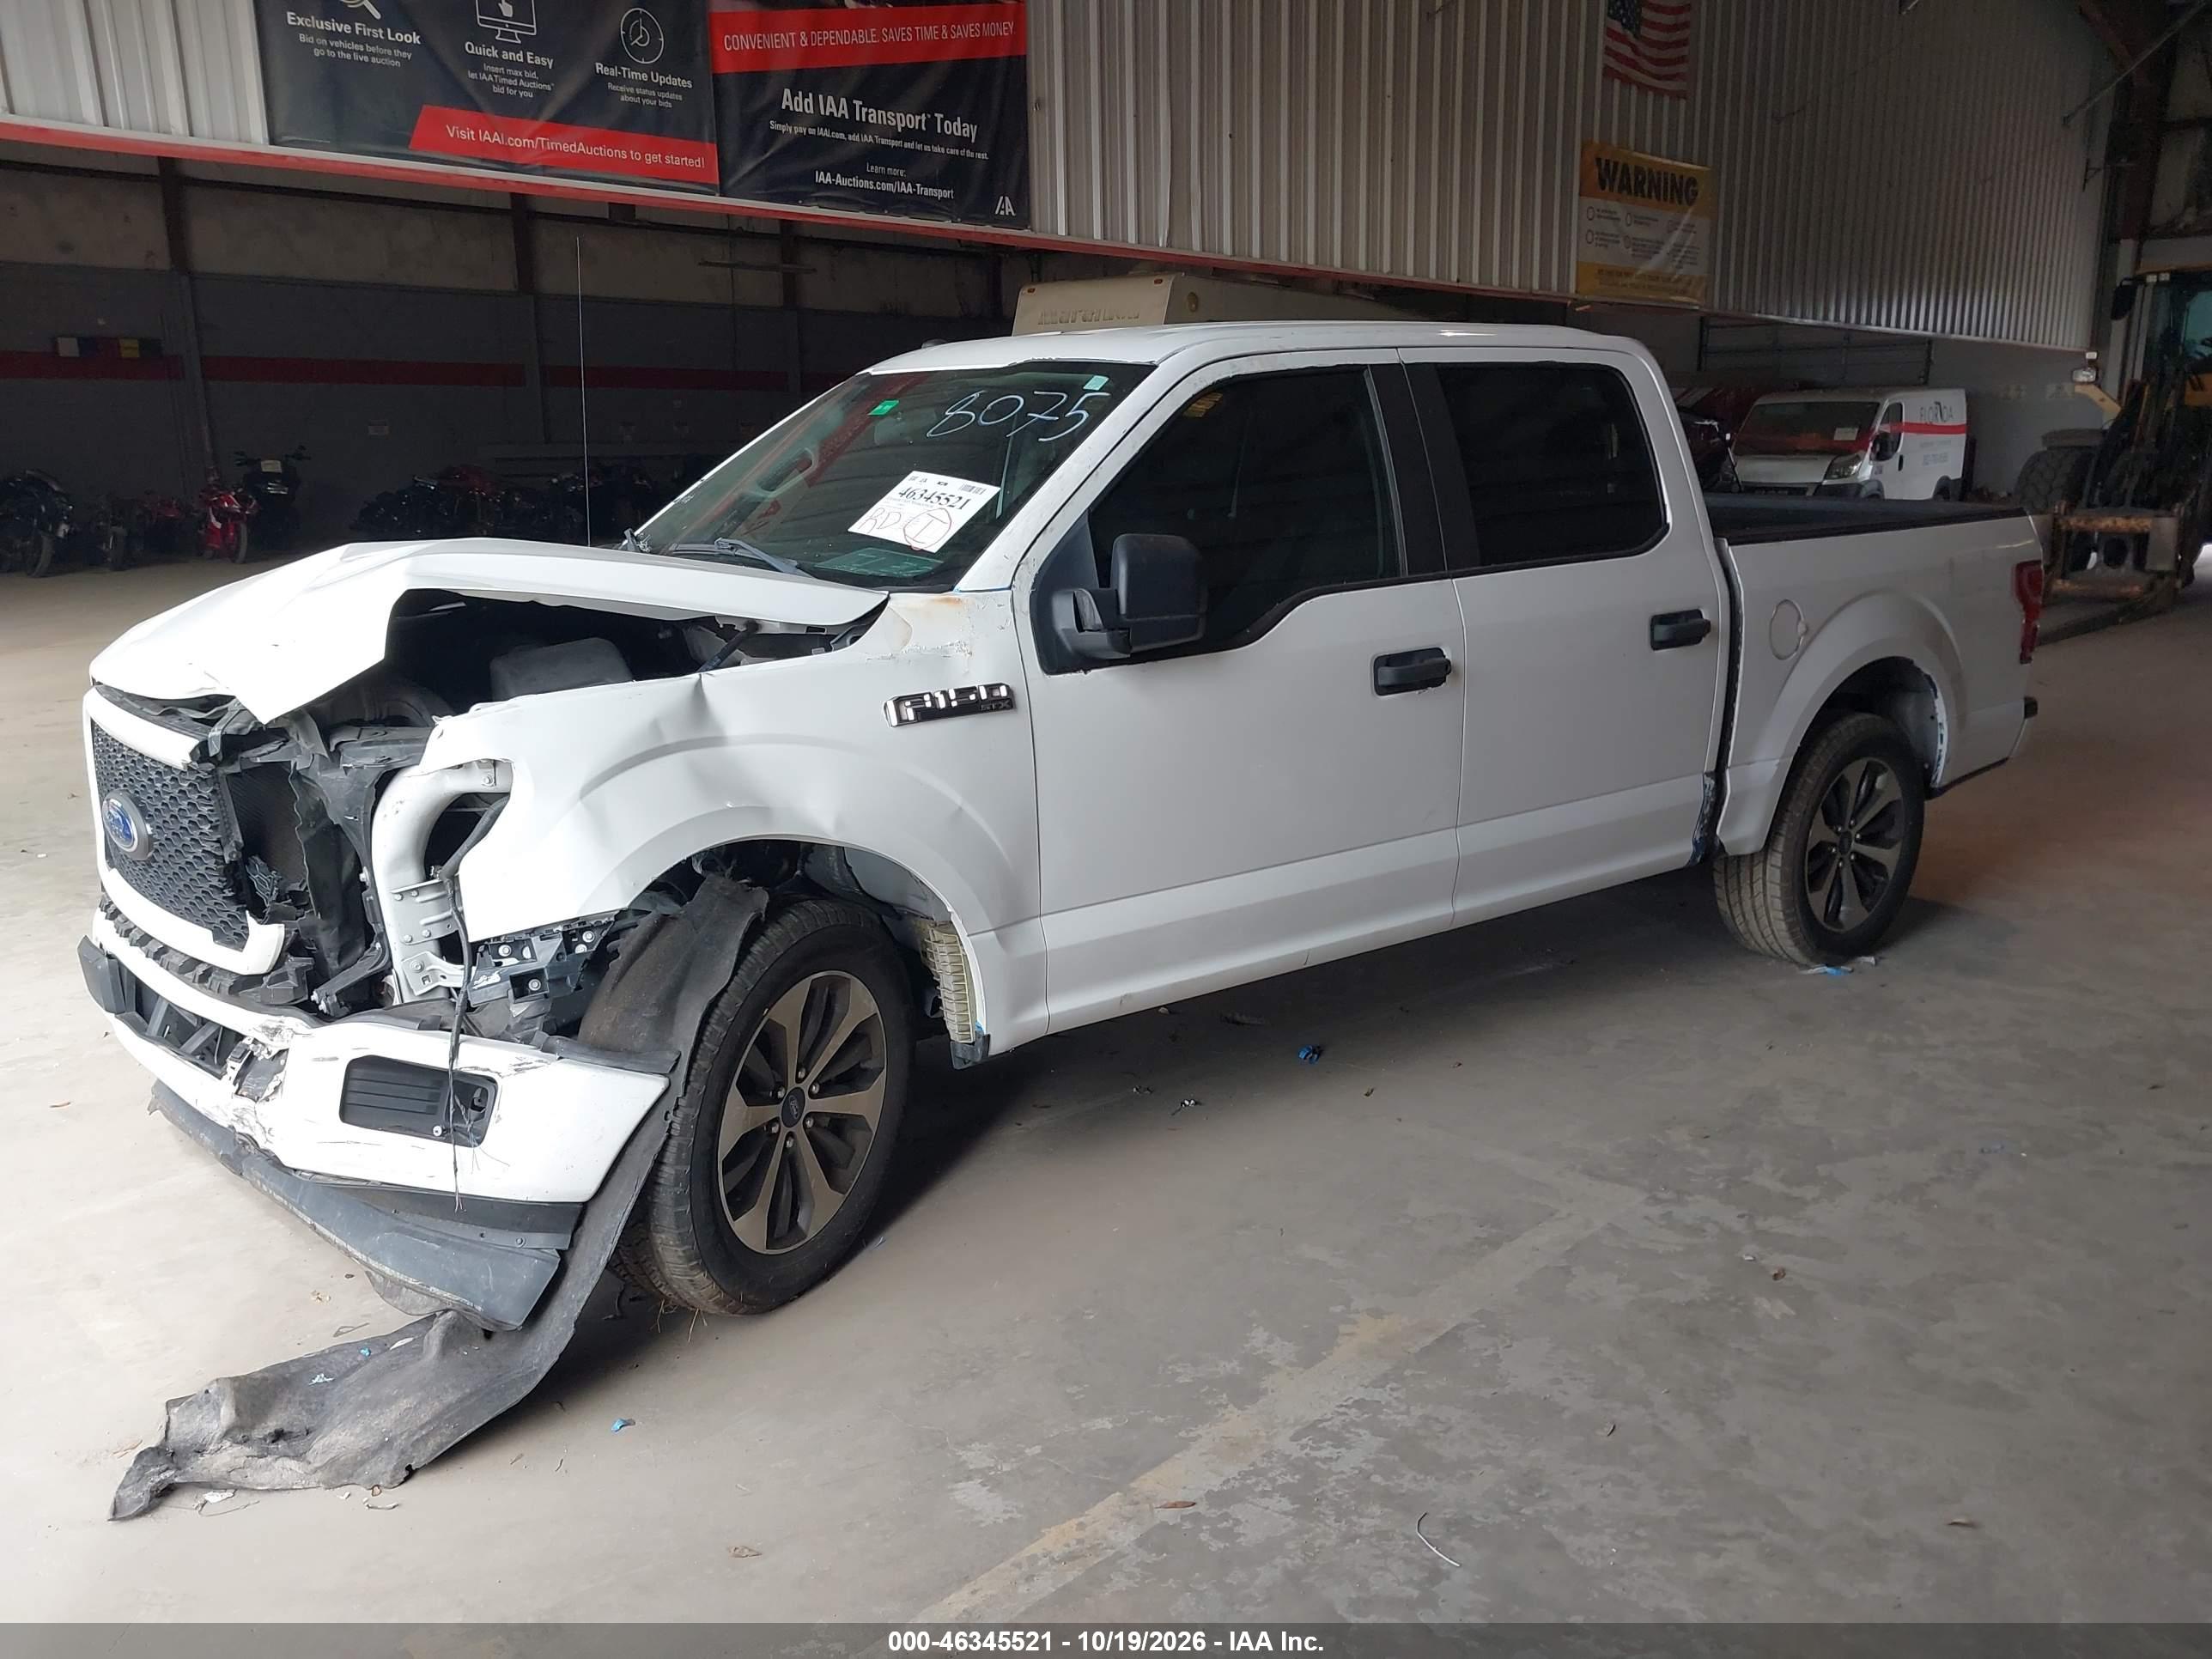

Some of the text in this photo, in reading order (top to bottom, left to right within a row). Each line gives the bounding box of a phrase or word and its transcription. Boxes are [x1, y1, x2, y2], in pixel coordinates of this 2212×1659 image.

[286, 11, 422, 45] Exclusive First Look
[724, 32, 797, 52] CONVENIENT
[799, 31, 809, 47] &
[811, 27, 880, 47] DEPENDABLE.
[882, 25, 913, 43] SAVES
[915, 23, 939, 40] TIME
[941, 21, 949, 40] &
[951, 21, 981, 39] SAVES
[299, 33, 412, 60] Bid on vehicles before they
[313, 47, 401, 68] go to the live auction
[465, 41, 554, 70] Quick and Easy
[467, 70, 478, 80] let
[494, 76, 518, 87] Timed
[483, 63, 505, 75] Insert
[506, 68, 523, 77] max
[595, 62, 693, 89] Real-Time Updates
[492, 85, 533, 99] bid for you
[607, 82, 684, 100] Receive status updates
[620, 94, 641, 104] about
[641, 97, 657, 106] your
[781, 88, 815, 114] Add
[817, 94, 849, 119] IAA
[933, 112, 978, 143] Today
[446, 125, 707, 169] Visit IAAI.com/TimedAuctions to get started!
[769, 120, 793, 134] Simply
[793, 125, 807, 137] pay
[808, 127, 817, 136] on
[848, 132, 860, 142] add
[860, 133, 874, 144] IAA
[874, 136, 903, 149] Transport
[903, 141, 915, 150] and
[932, 144, 945, 154] take
[975, 151, 989, 160] rest.
[866, 162, 907, 178] Learn more:
[1595, 157, 1698, 208] WARNING
[815, 170, 955, 200] IAA-Auctions.com/IAA-Transport
[898, 486, 971, 511] 46345521
[883, 682, 1012, 727] F150
